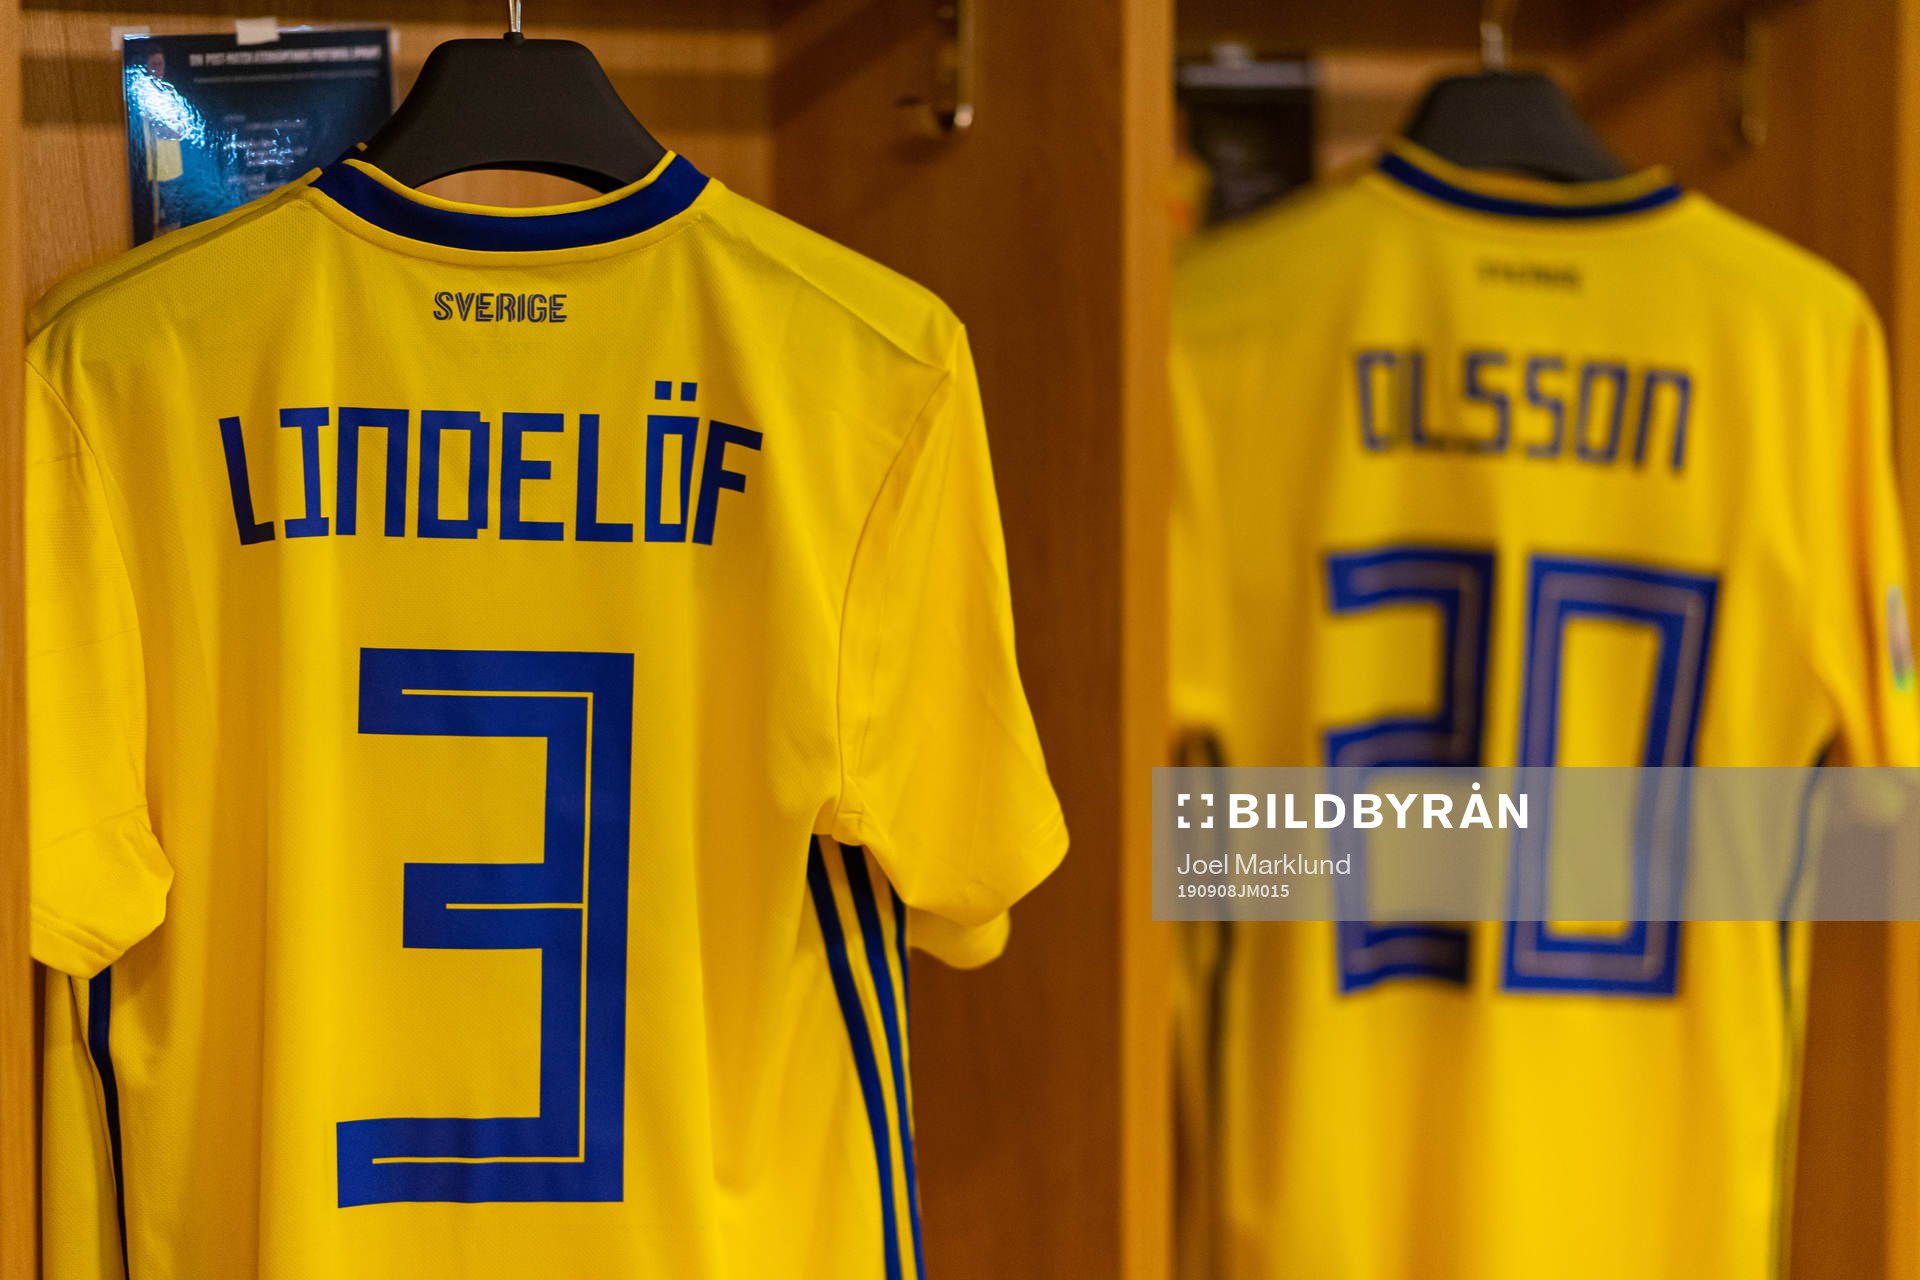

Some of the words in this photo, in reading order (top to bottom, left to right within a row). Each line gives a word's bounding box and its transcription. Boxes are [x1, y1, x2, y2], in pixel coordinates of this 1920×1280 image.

[433, 290, 568, 323] SVERIGE
[218, 380, 763, 546] LINDELÖF
[1355, 348, 1695, 475] OLSSON
[1323, 545, 1720, 999] 20
[336, 647, 635, 1208] 3
